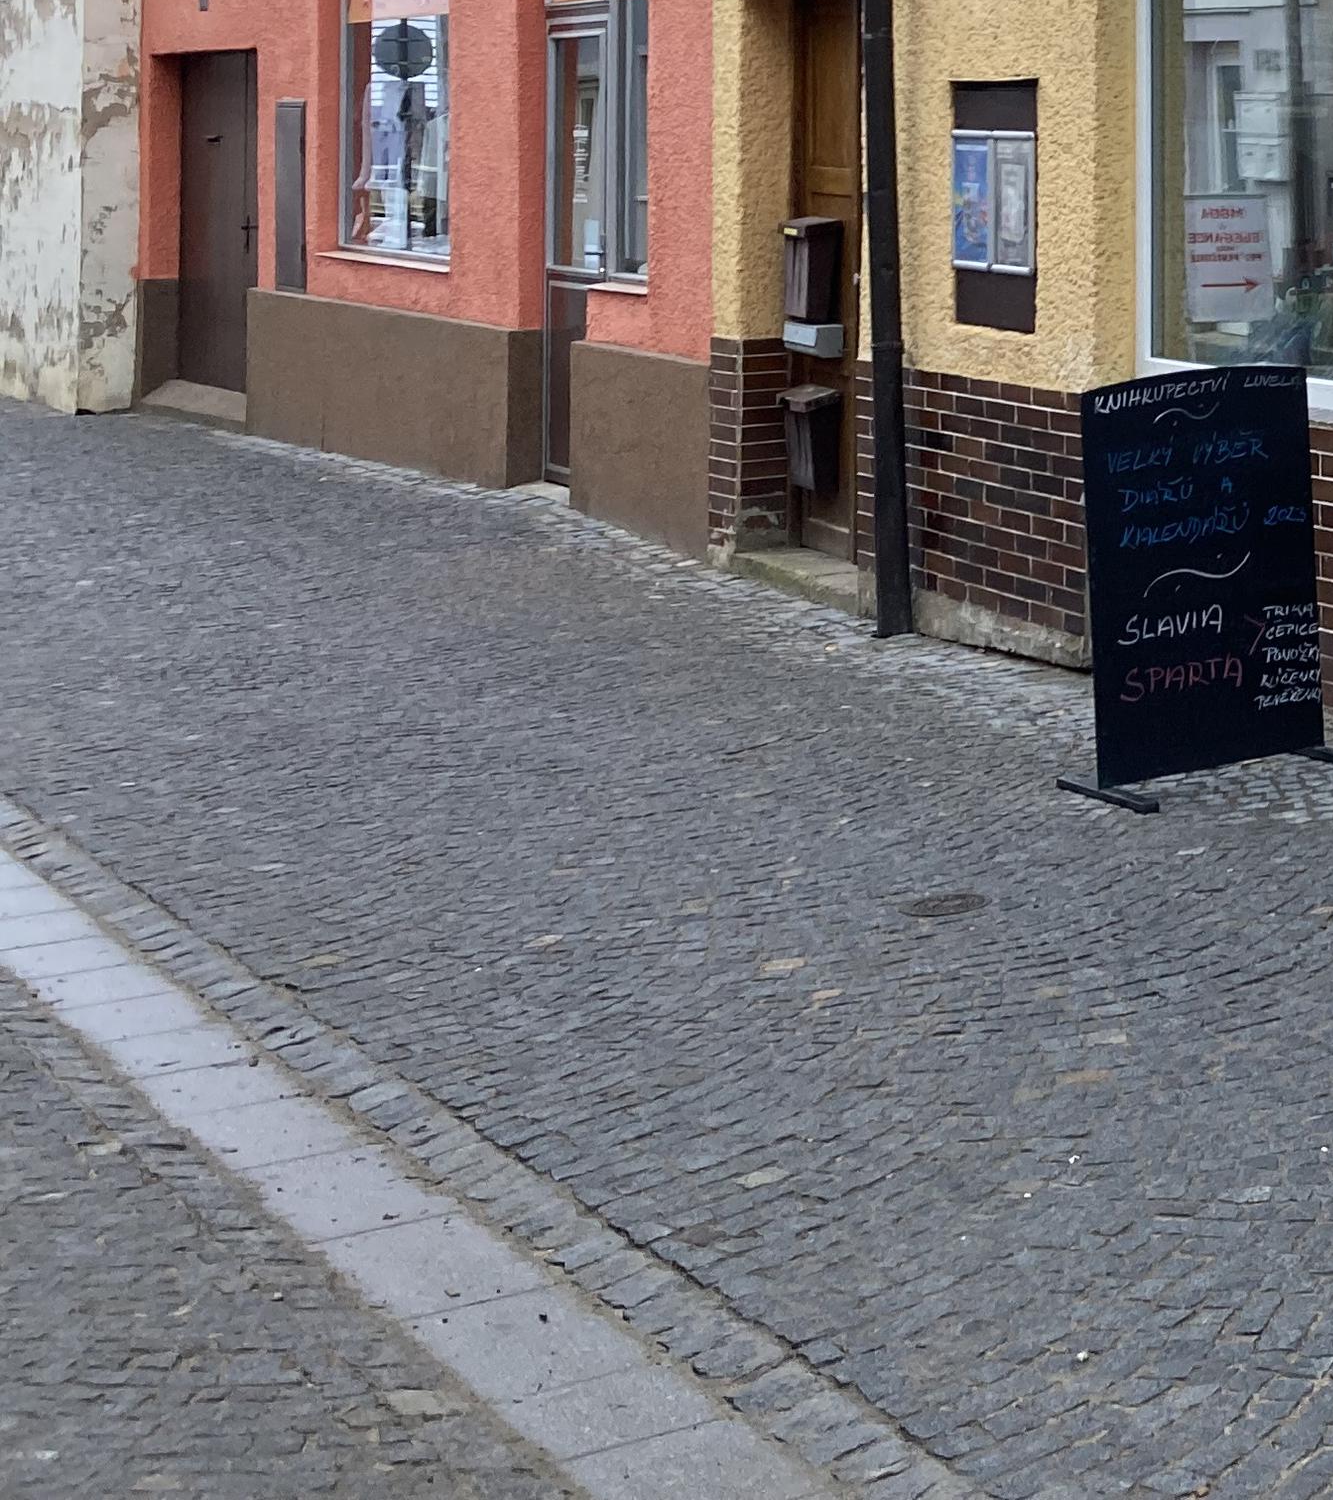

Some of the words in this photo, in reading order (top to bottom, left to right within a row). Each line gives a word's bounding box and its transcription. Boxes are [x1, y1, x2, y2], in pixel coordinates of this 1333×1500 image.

[1094, 371, 1231, 414] KNIHKUPECTVÍ
[1107, 435, 1174, 474] VELKÝ
[1193, 429, 1269, 466] VÝBĚR
[1117, 603, 1223, 645] SLAVIA
[1262, 602, 1315, 619] TRIKA
[1265, 619, 1319, 640] ČEPICE
[1120, 652, 1244, 702] SPARTA
